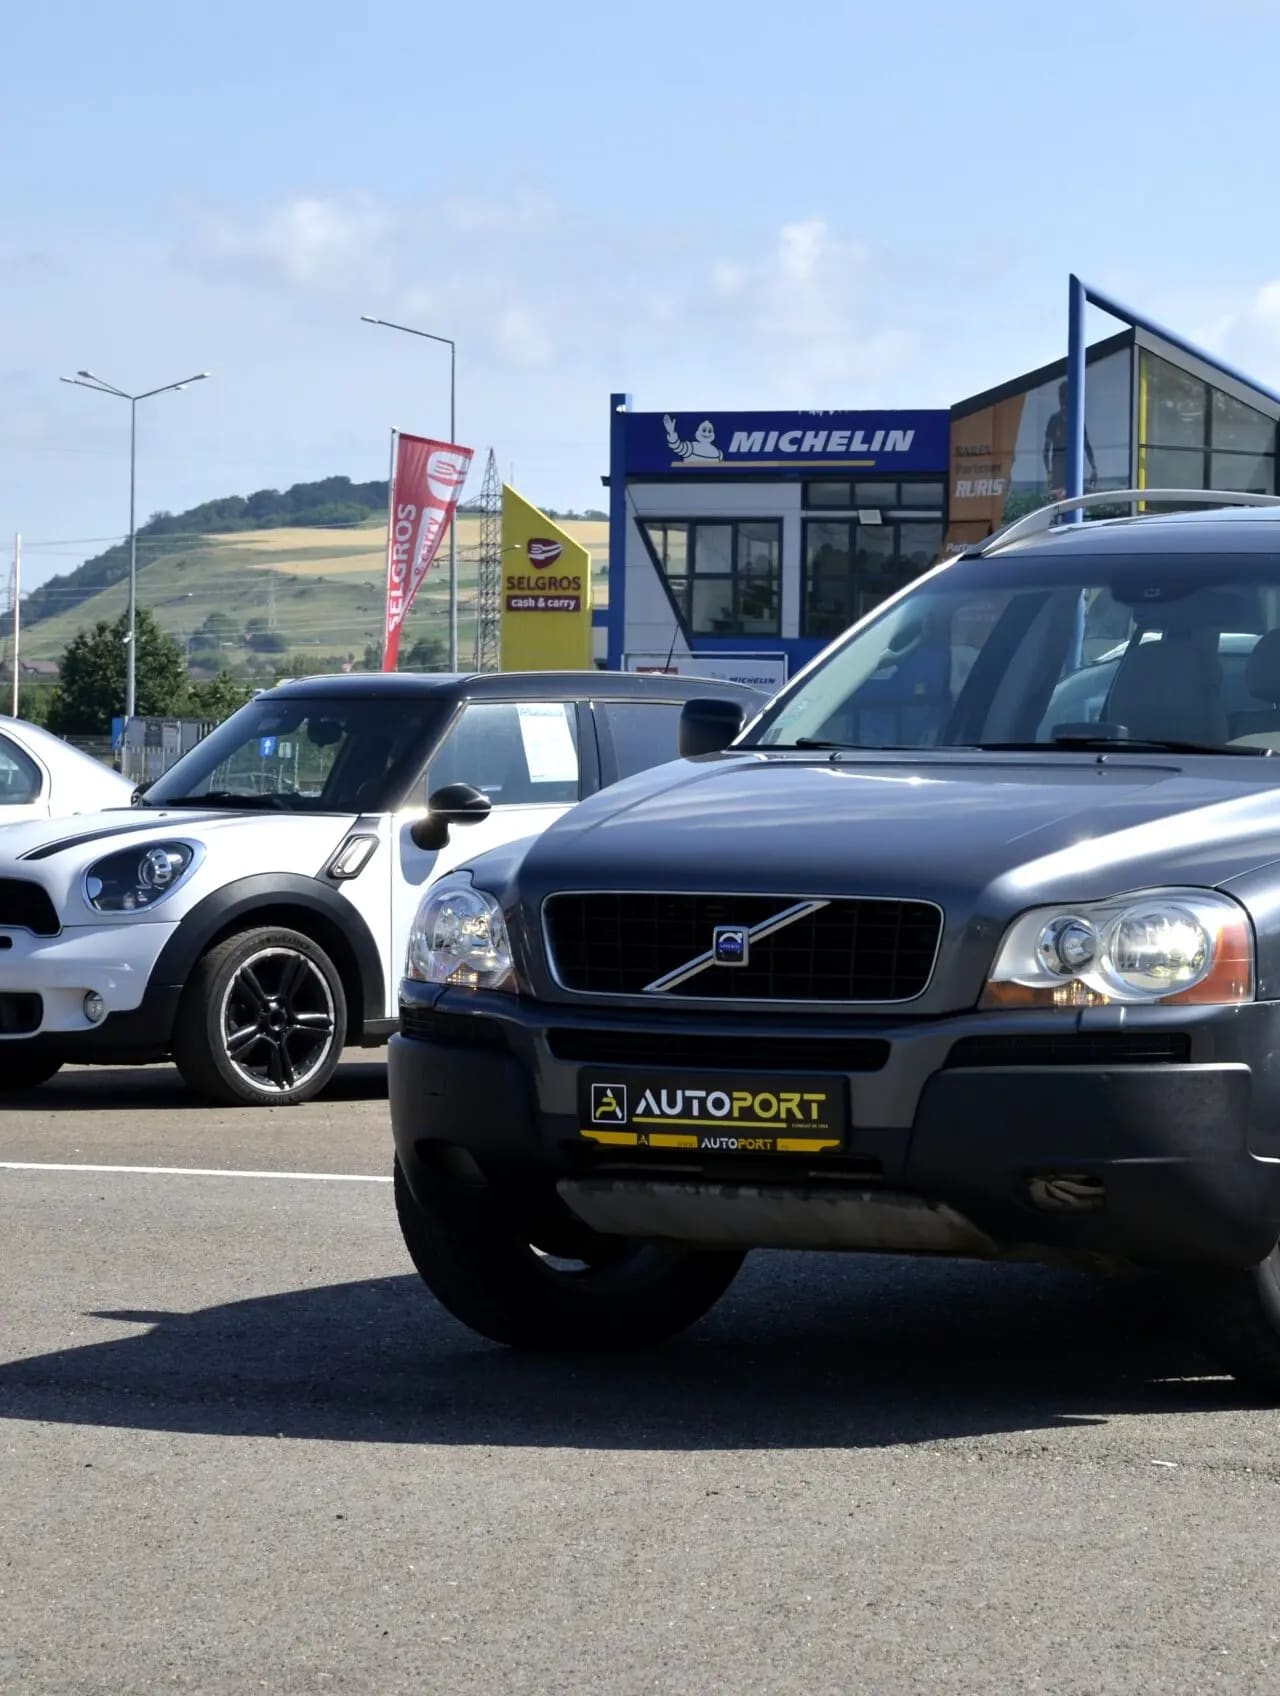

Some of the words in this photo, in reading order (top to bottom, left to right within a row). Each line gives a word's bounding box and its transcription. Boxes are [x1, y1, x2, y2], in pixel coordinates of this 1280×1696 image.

[728, 430, 915, 453] MICHELIN
[389, 503, 416, 632] SELGROS
[506, 575, 582, 591] SELGROS
[511, 597, 535, 608] cash
[536, 597, 546, 608] &
[547, 599, 577, 611] carry
[635, 1087, 827, 1120] AUTOPORT
[700, 1137, 773, 1150] AUTOPORT
